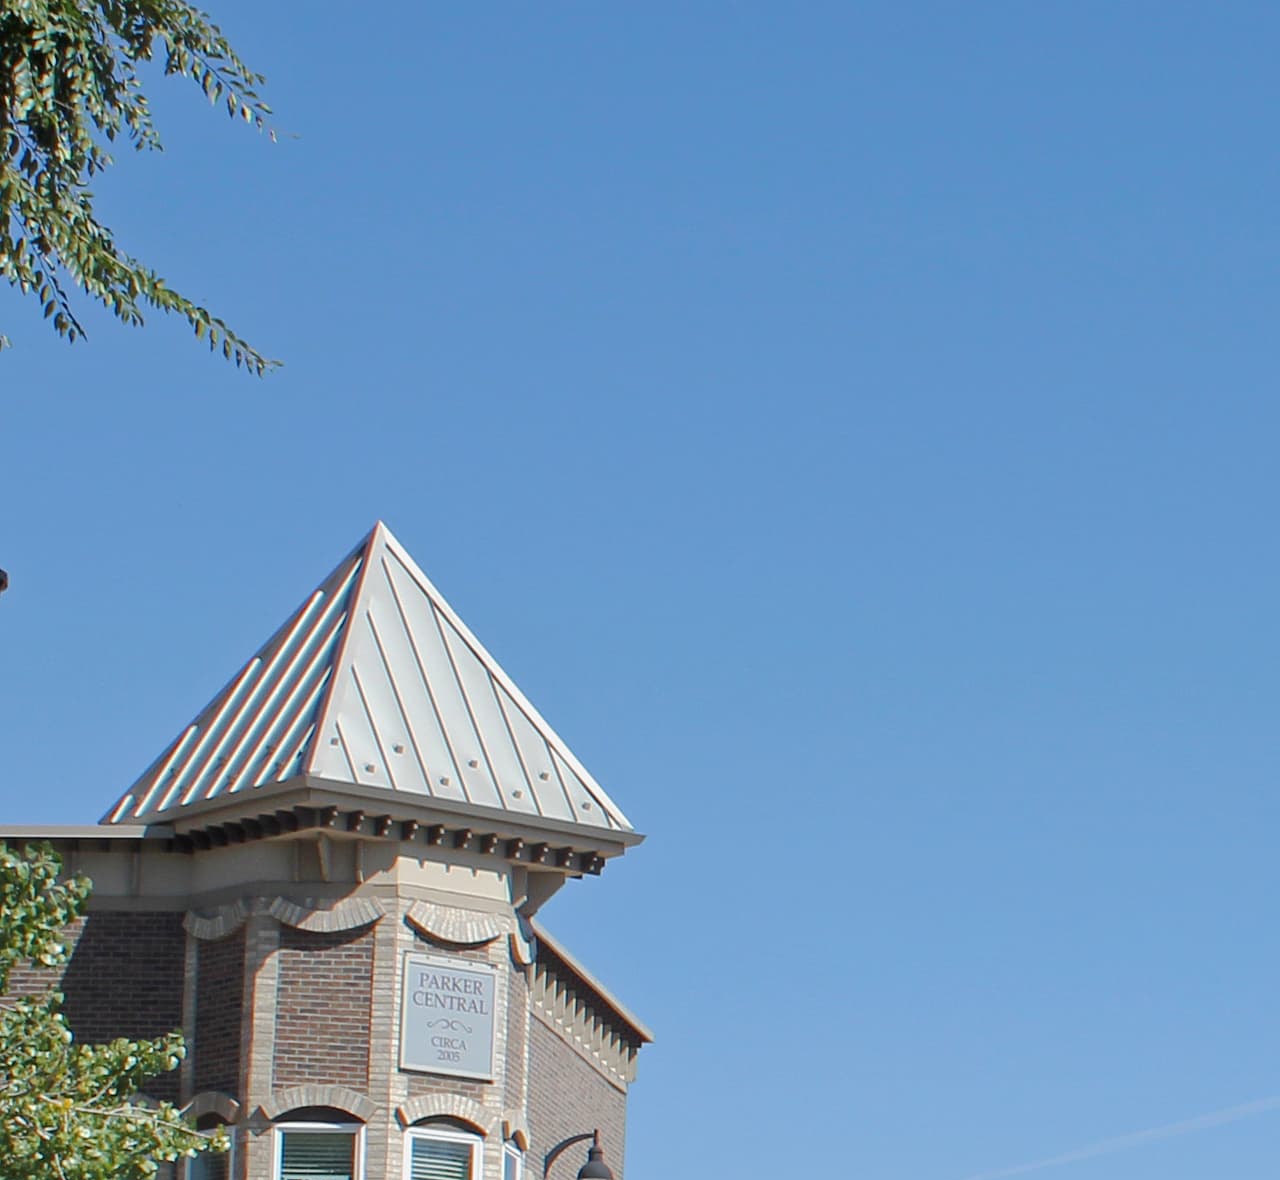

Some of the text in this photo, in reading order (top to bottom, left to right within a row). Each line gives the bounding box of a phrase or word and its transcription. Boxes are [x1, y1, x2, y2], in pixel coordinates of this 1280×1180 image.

[419, 972, 483, 995] PARKER
[412, 991, 488, 1015] CENTRAL
[431, 1036, 467, 1050] CIRCA
[437, 1050, 460, 1061] 2005
